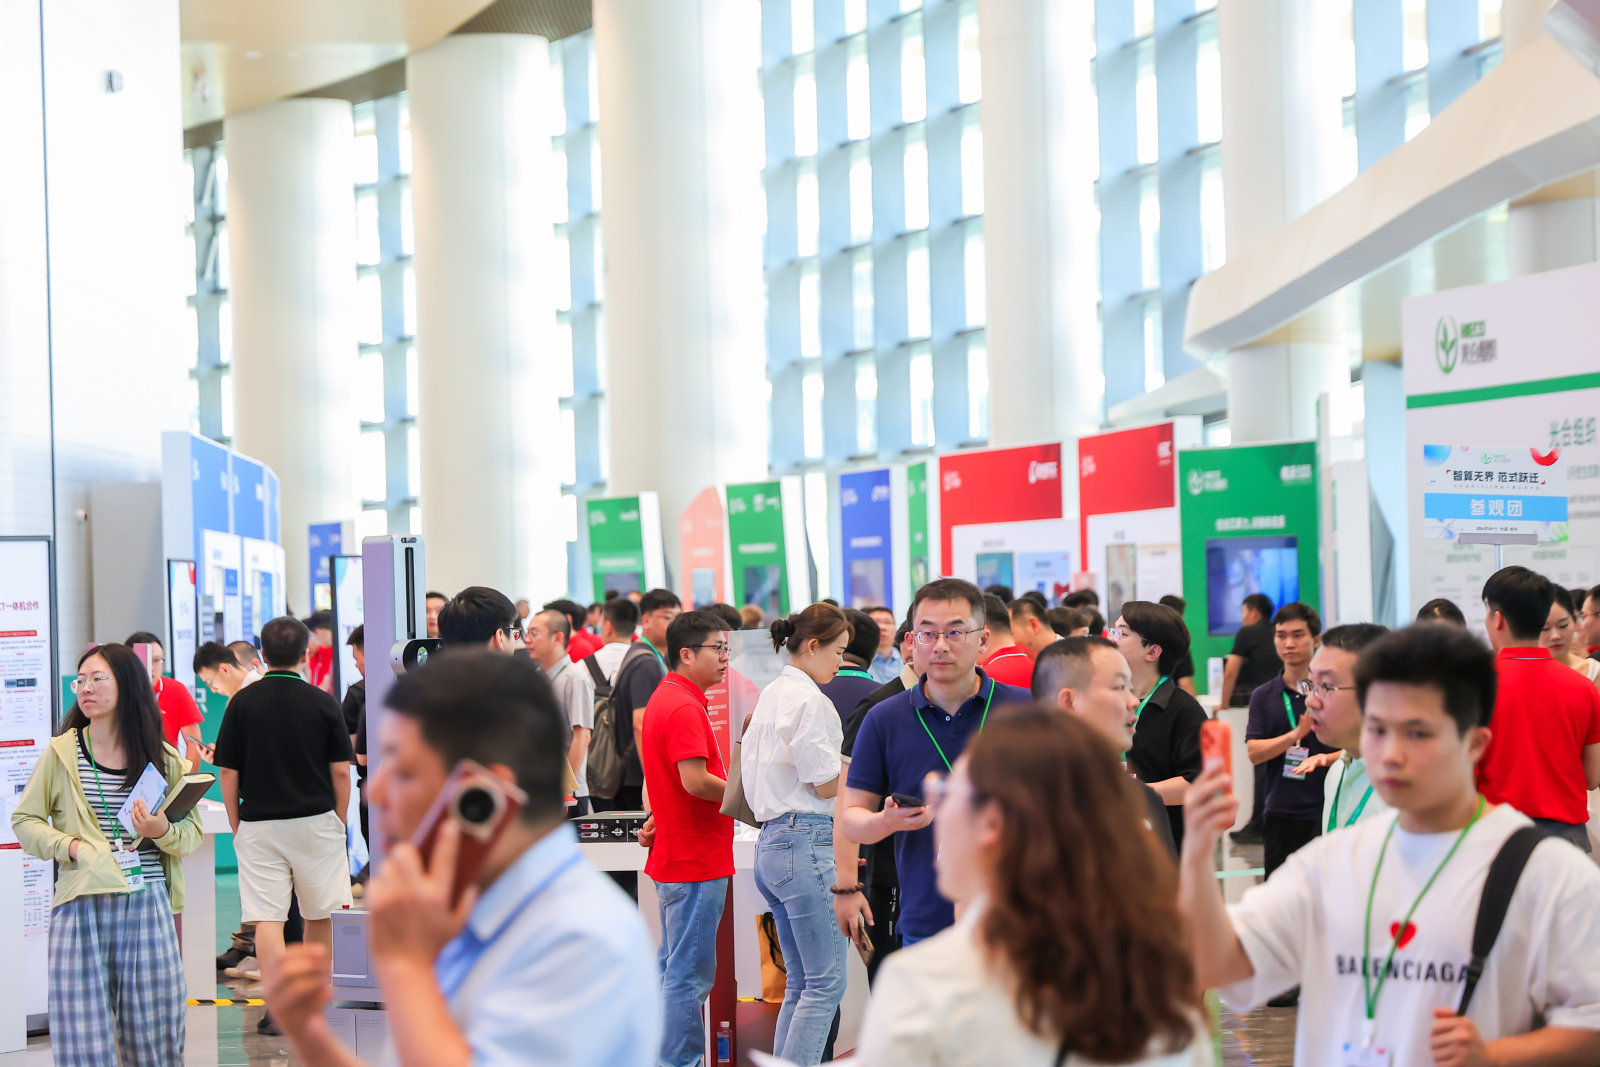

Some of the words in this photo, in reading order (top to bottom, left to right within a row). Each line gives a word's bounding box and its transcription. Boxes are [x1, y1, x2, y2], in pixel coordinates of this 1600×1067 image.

[1453, 470, 1494, 482] 智算无界
[1498, 472, 1539, 483] 范式跃迁
[1470, 499, 1523, 517] 参观团
